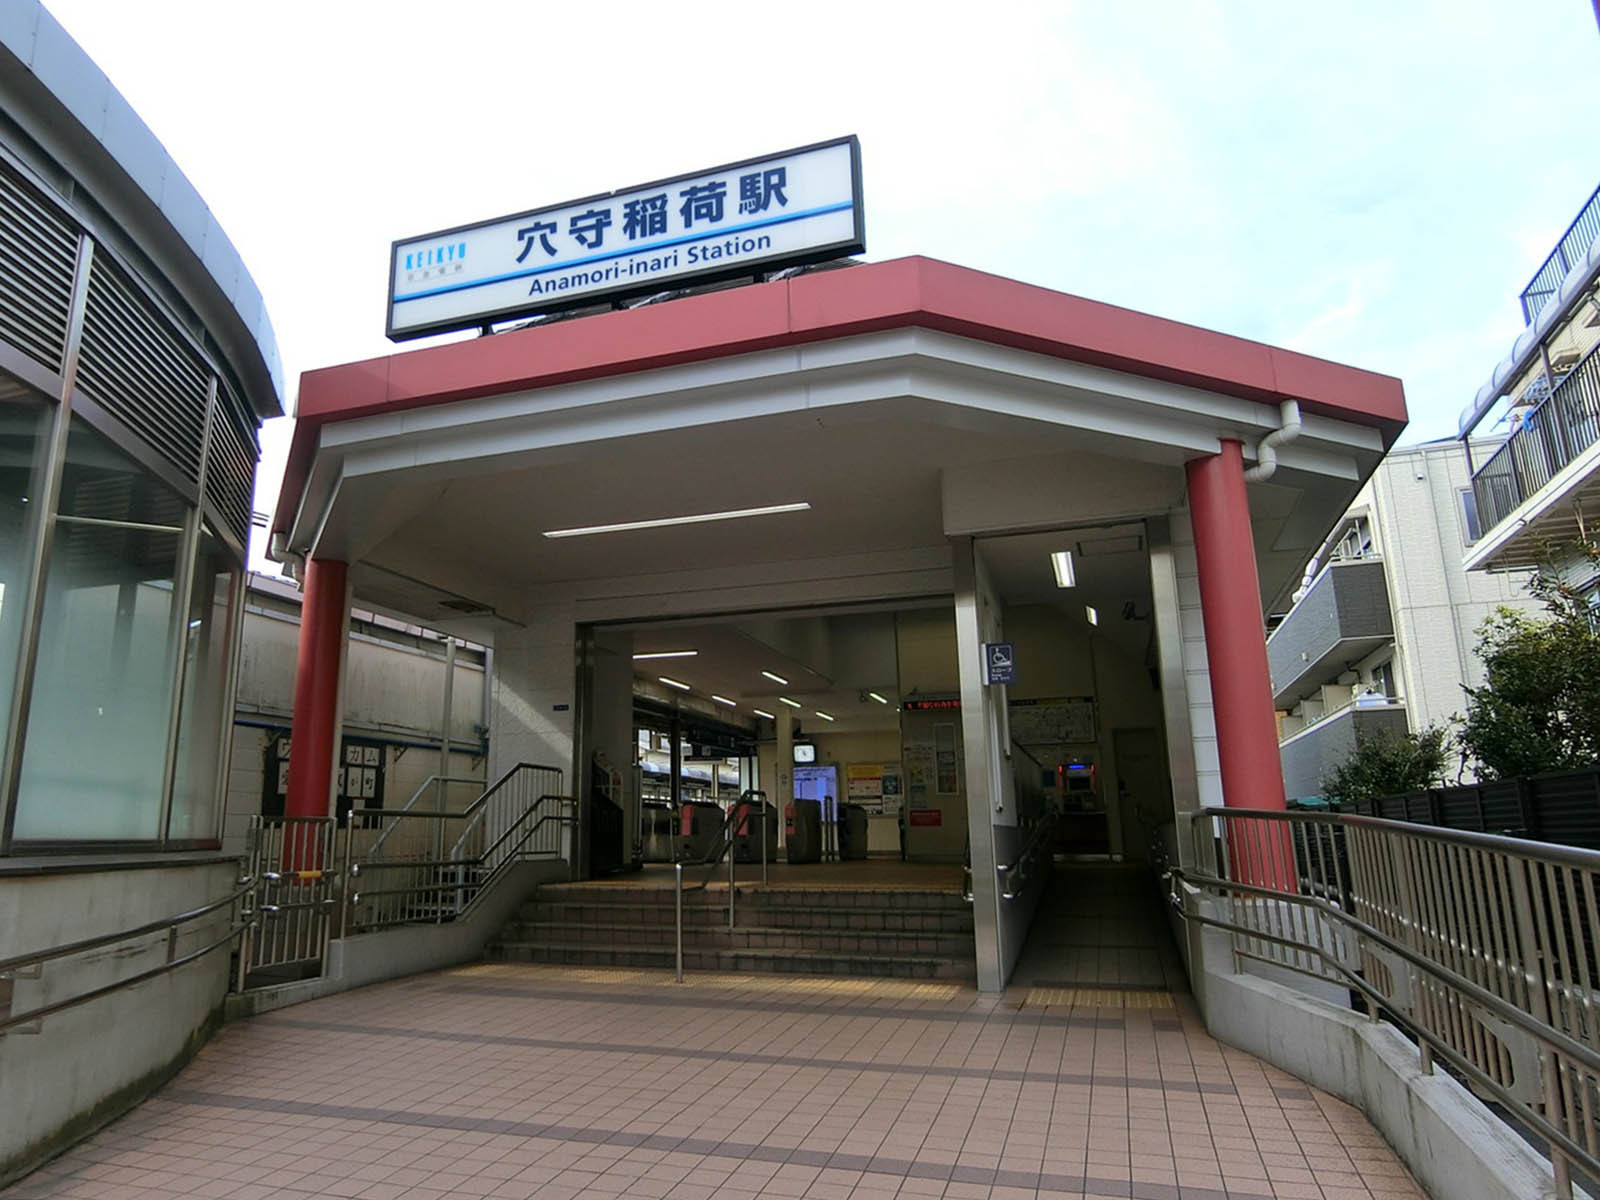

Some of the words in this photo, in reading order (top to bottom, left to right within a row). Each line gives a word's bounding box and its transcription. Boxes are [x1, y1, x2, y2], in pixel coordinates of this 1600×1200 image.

[516, 166, 788, 263] 穴守稲荷駅
[406, 242, 466, 270] KEIKYU
[528, 251, 678, 296] Anamori-inari
[687, 235, 771, 264] Station
